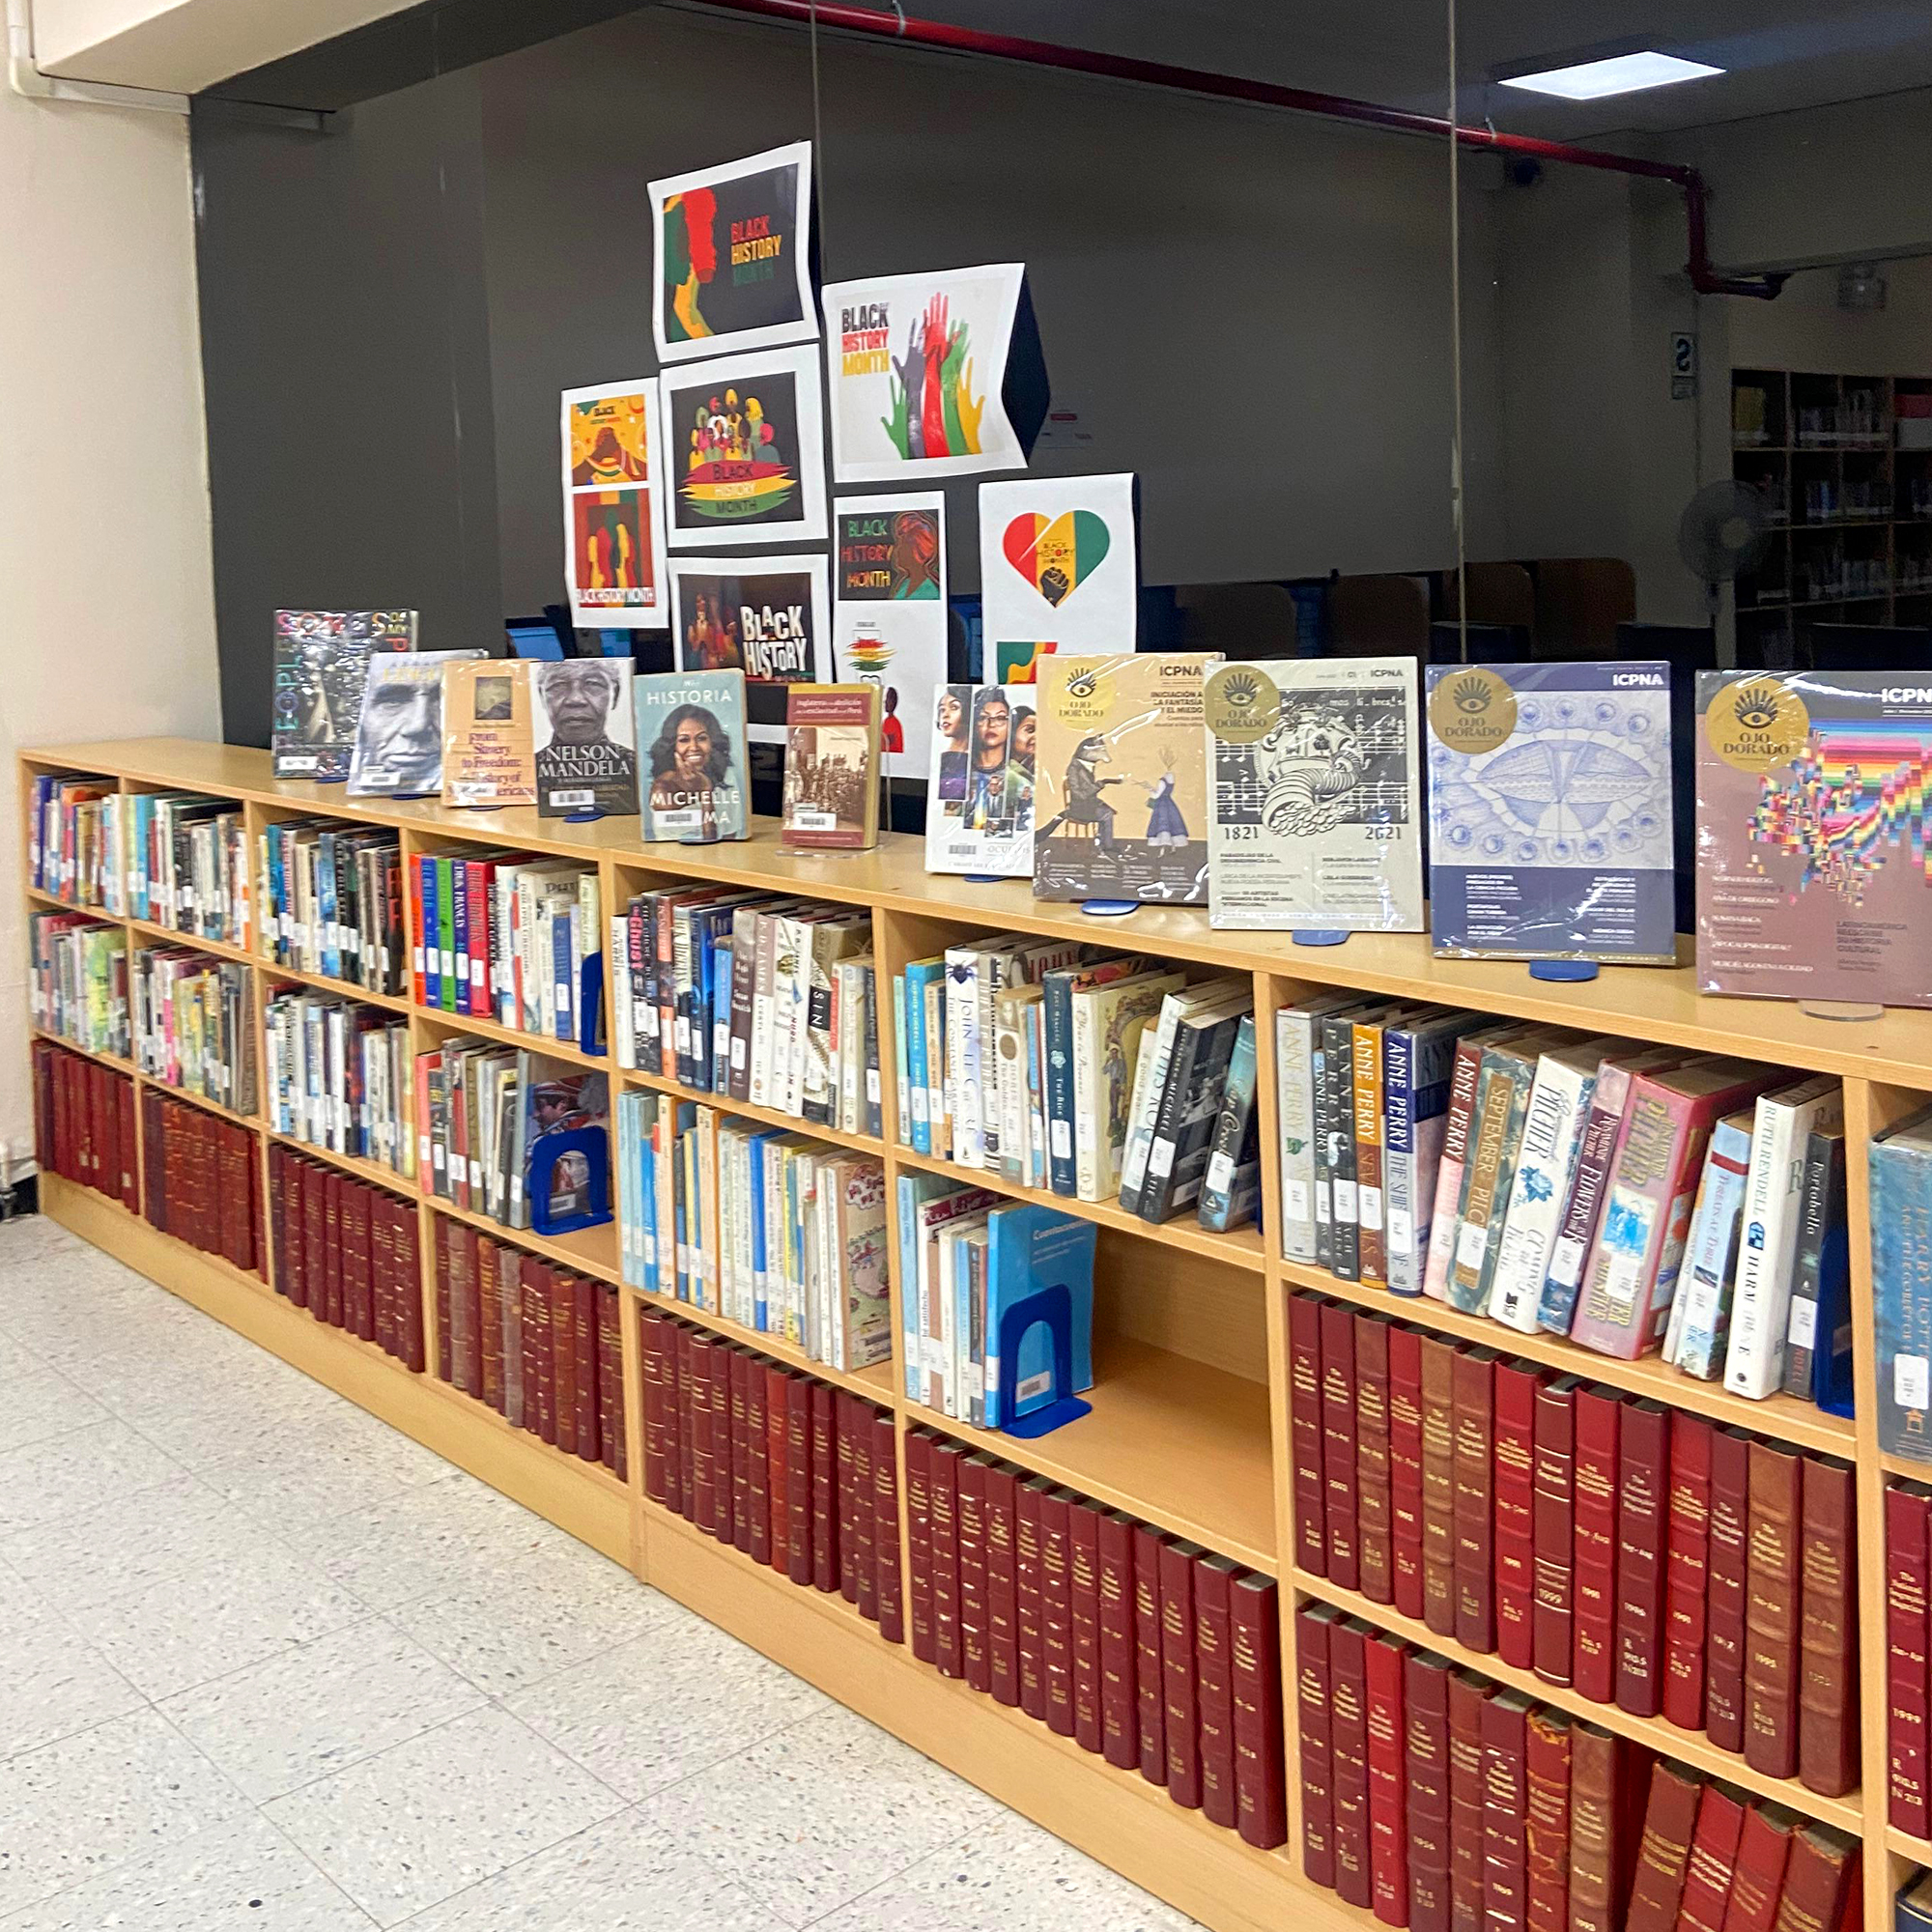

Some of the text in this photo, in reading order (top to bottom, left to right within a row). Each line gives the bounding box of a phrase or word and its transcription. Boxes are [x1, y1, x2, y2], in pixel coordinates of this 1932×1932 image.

[731, 214, 770, 243] BLACK
[731, 235, 781, 266] HISTORY
[841, 302, 891, 333] BLACK
[841, 328, 890, 354] HISTORY
[842, 349, 891, 377] MONTH
[712, 464, 753, 481] BLACK
[715, 482, 757, 497] HISTORY
[716, 499, 757, 514] MONTH
[847, 519, 888, 538] BLACK
[840, 544, 894, 562] HISTORY
[847, 570, 891, 588] MONTH
[740, 606, 805, 640] BLACK
[743, 638, 808, 681] HISTORY
[1159, 666, 1204, 676] ICPNA
[1612, 673, 1664, 686] ICPNA
[646, 690, 733, 705] HISTORIA
[1059, 709, 1104, 718] DORADO
[1215, 719, 1267, 728] DORADO
[1458, 717, 1486, 727] OJO
[1444, 726, 1503, 737] DORADO
[1740, 732, 1770, 743] OJO
[546, 745, 620, 761] NELSON
[1723, 743, 1790, 755] DORADO
[538, 760, 631, 777] MANDELA
[649, 791, 741, 807] MICHELLE
[1224, 826, 1402, 840] 1821 2021
[454, 891, 466, 928] FRANCIS
[629, 916, 643, 969] Ghost
[758, 951, 769, 995] JAMES
[811, 991, 827, 1026] SIN
[958, 999, 974, 1039] JOHN
[1325, 1029, 1339, 1128] PERRY
[1338, 1039, 1352, 1120] ANNE
[1354, 1035, 1377, 1142] ANNE PERRY
[1159, 1082, 1179, 1132] MICHAEL
[1315, 1065, 1328, 1154] ANNE PERRY
[1387, 1042, 1407, 1150] ANNE PERRY
[1444, 1054, 1476, 1161] ANNE PERRY
[1523, 1083, 1562, 1159] PILCHER
[1389, 1155, 1406, 1179] THE
[1468, 1089, 1509, 1225] SEPTEMBER PILC
[1573, 1163, 1603, 1229] FLOWERS
[1805, 1159, 1826, 1236] Portobello
[1743, 1255, 1762, 1302] HARM
[1916, 1295, 1931, 1359] POTT
